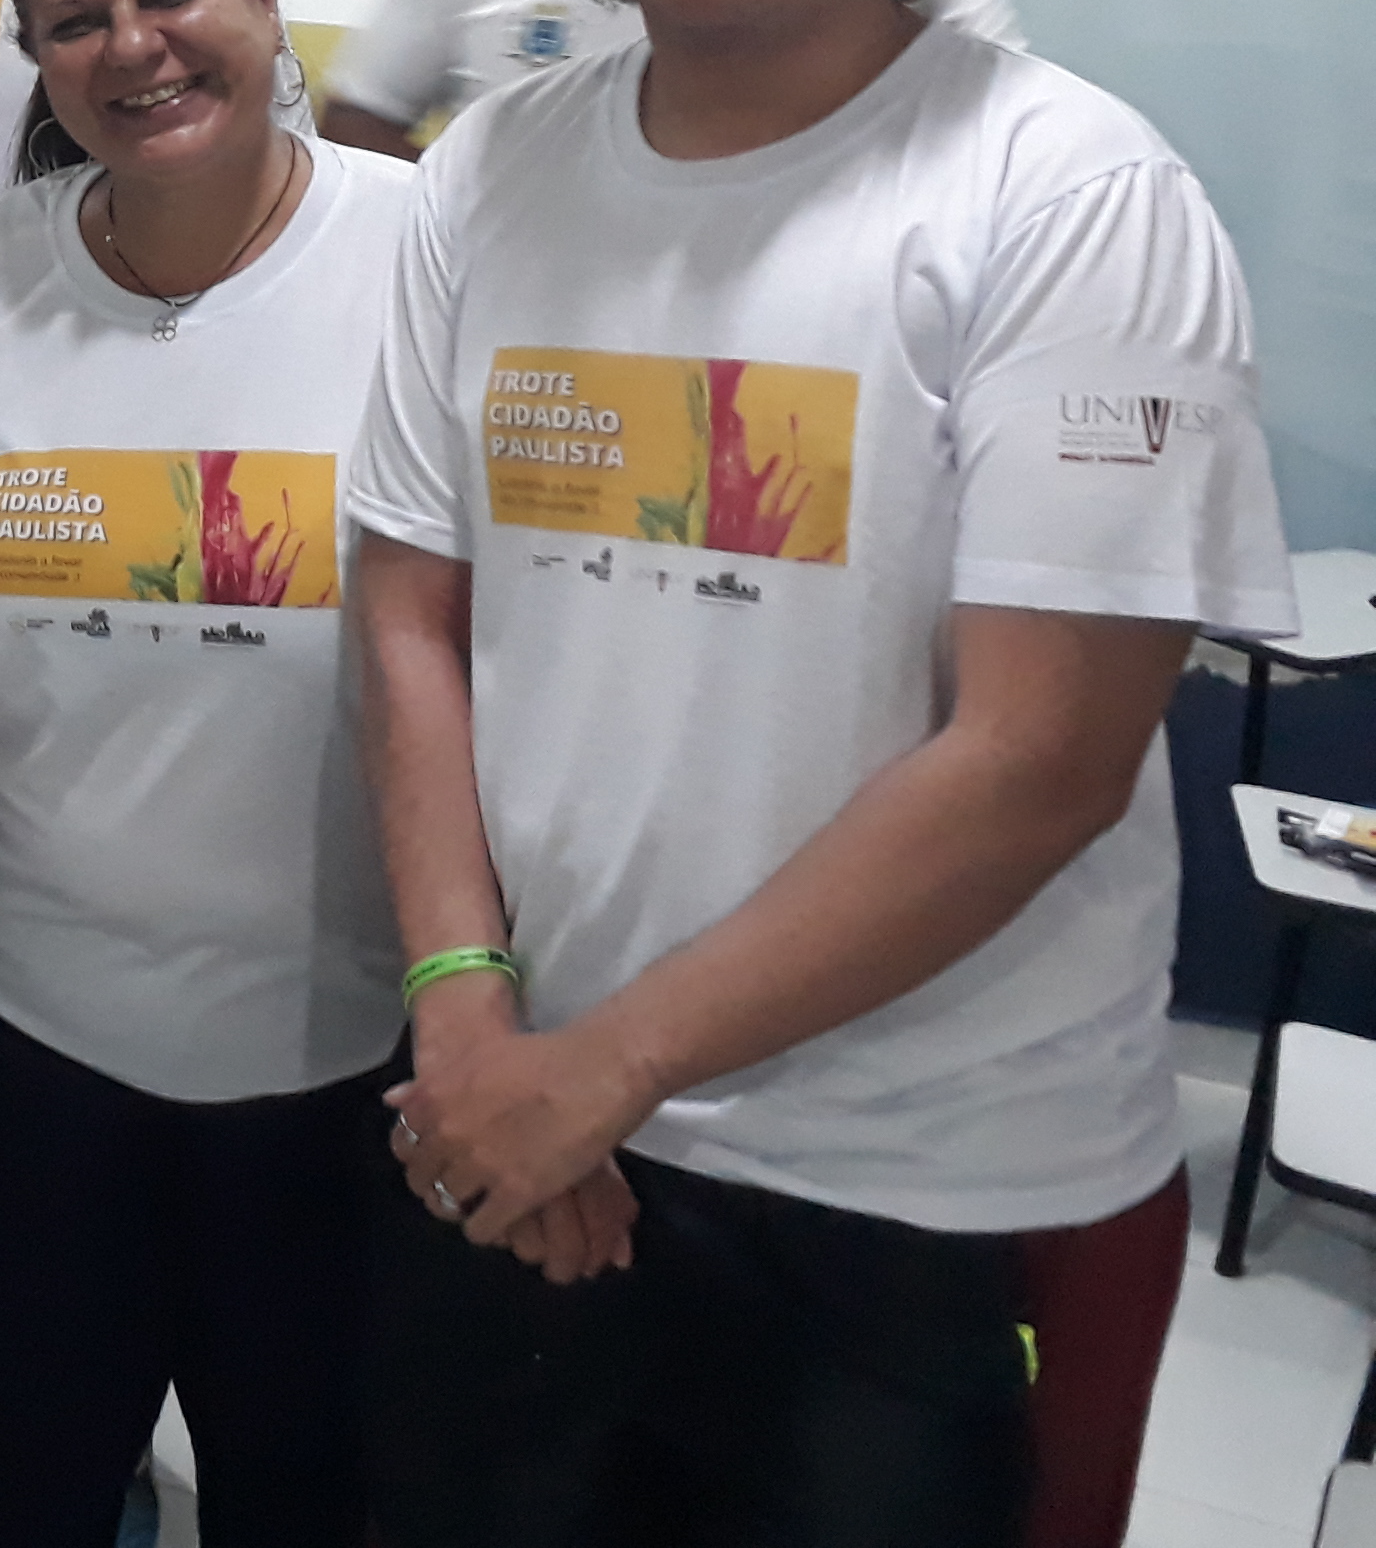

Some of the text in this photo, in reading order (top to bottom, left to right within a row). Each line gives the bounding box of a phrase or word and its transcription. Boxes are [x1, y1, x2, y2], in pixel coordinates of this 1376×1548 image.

[491, 369, 576, 396] TROTE
[488, 400, 622, 435] CIDADÃO
[490, 435, 625, 468] PAULISTA
